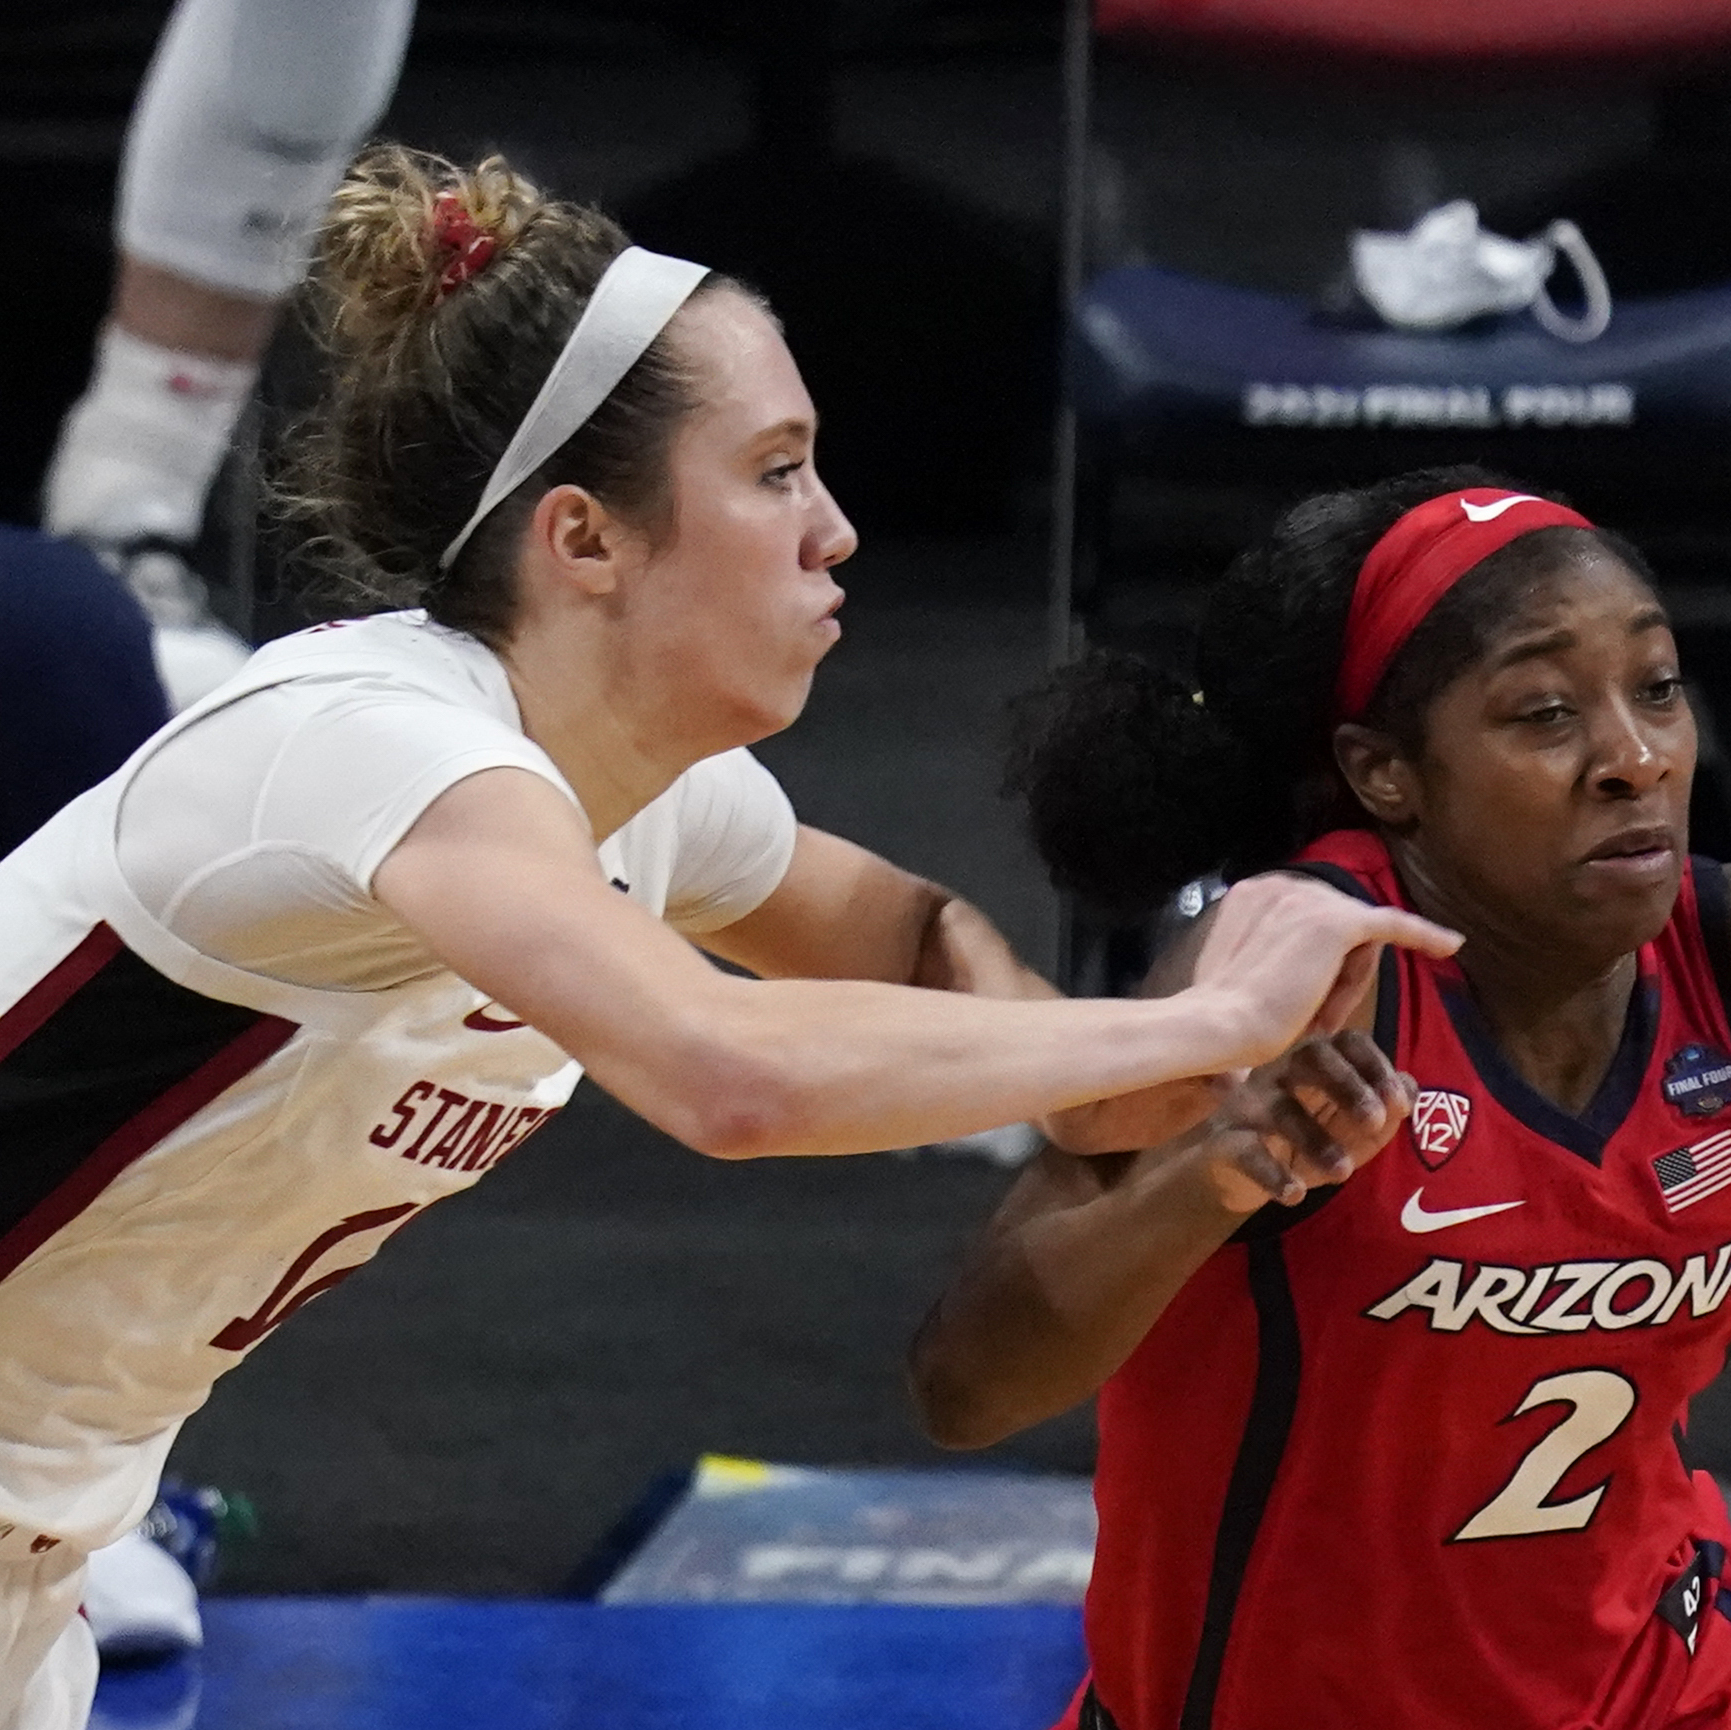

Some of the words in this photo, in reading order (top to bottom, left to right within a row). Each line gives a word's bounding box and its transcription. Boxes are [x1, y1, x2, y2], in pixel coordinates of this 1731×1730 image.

[1363, 382, 1494, 427] FINAL
[1504, 382, 1634, 427] FOUR
[1668, 1076, 1703, 1096] FINAL
[1412, 1090, 1470, 1140] PAC
[1420, 1122, 1453, 1154] 12
[1442, 1364, 1641, 1546] 2
[745, 1545, 1095, 1583] FINA
